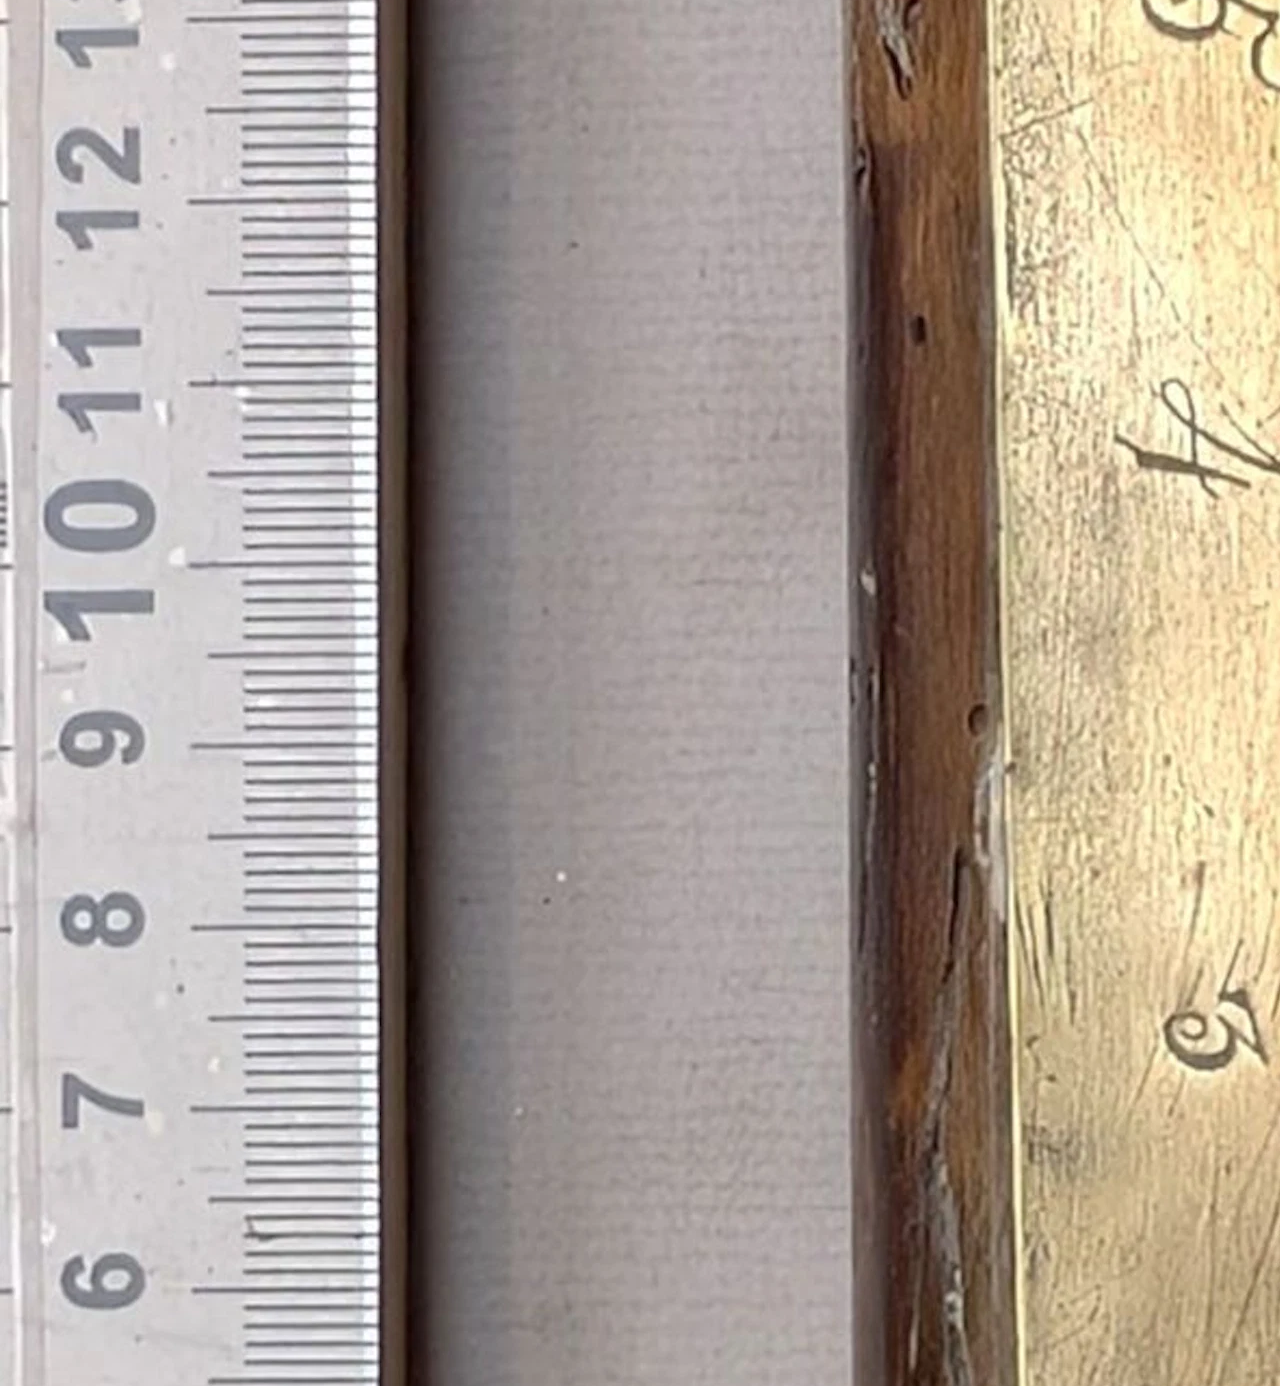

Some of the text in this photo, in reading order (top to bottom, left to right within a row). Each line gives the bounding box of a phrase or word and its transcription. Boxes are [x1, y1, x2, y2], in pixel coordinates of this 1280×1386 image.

[55, 125, 142, 252] 12
[56, 327, 143, 434] 11
[43, 479, 157, 643] 10
[59, 709, 146, 769] 9
[60, 891, 146, 949] 8
[60, 1071, 145, 1131] 7
[60, 1252, 147, 1311] 6
